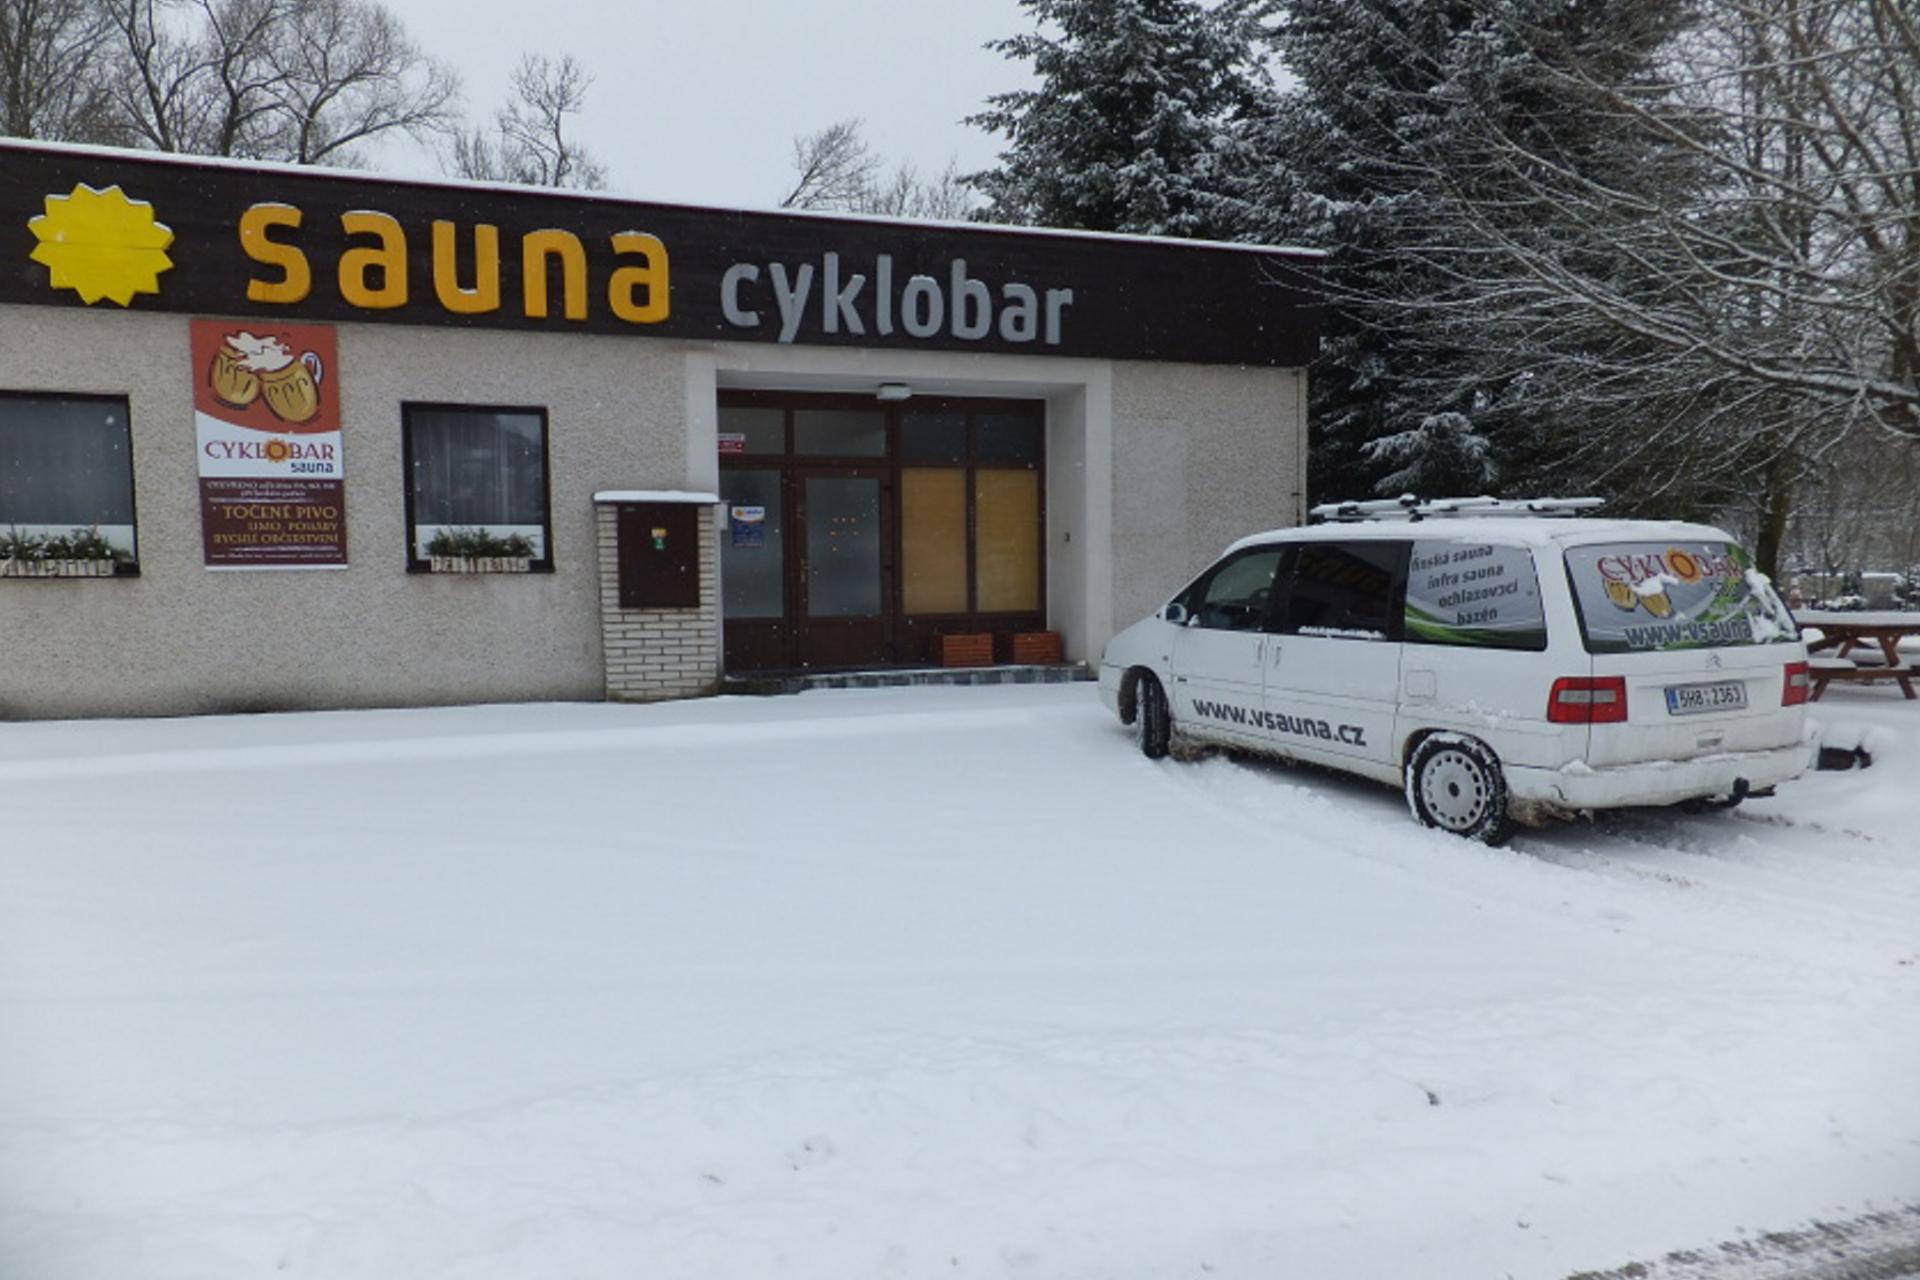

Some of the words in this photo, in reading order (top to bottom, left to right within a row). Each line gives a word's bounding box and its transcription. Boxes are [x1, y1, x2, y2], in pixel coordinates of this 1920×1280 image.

[238, 202, 671, 324] sauna
[720, 251, 1073, 344] cyklobar
[204, 439, 334, 462] CYKLOBAR
[290, 462, 334, 473] sauna
[296, 505, 338, 519] PIVO
[1452, 545, 1494, 563] sauna
[1462, 564, 1505, 583] sauna
[1193, 699, 1367, 747] www.vsauna.cz
